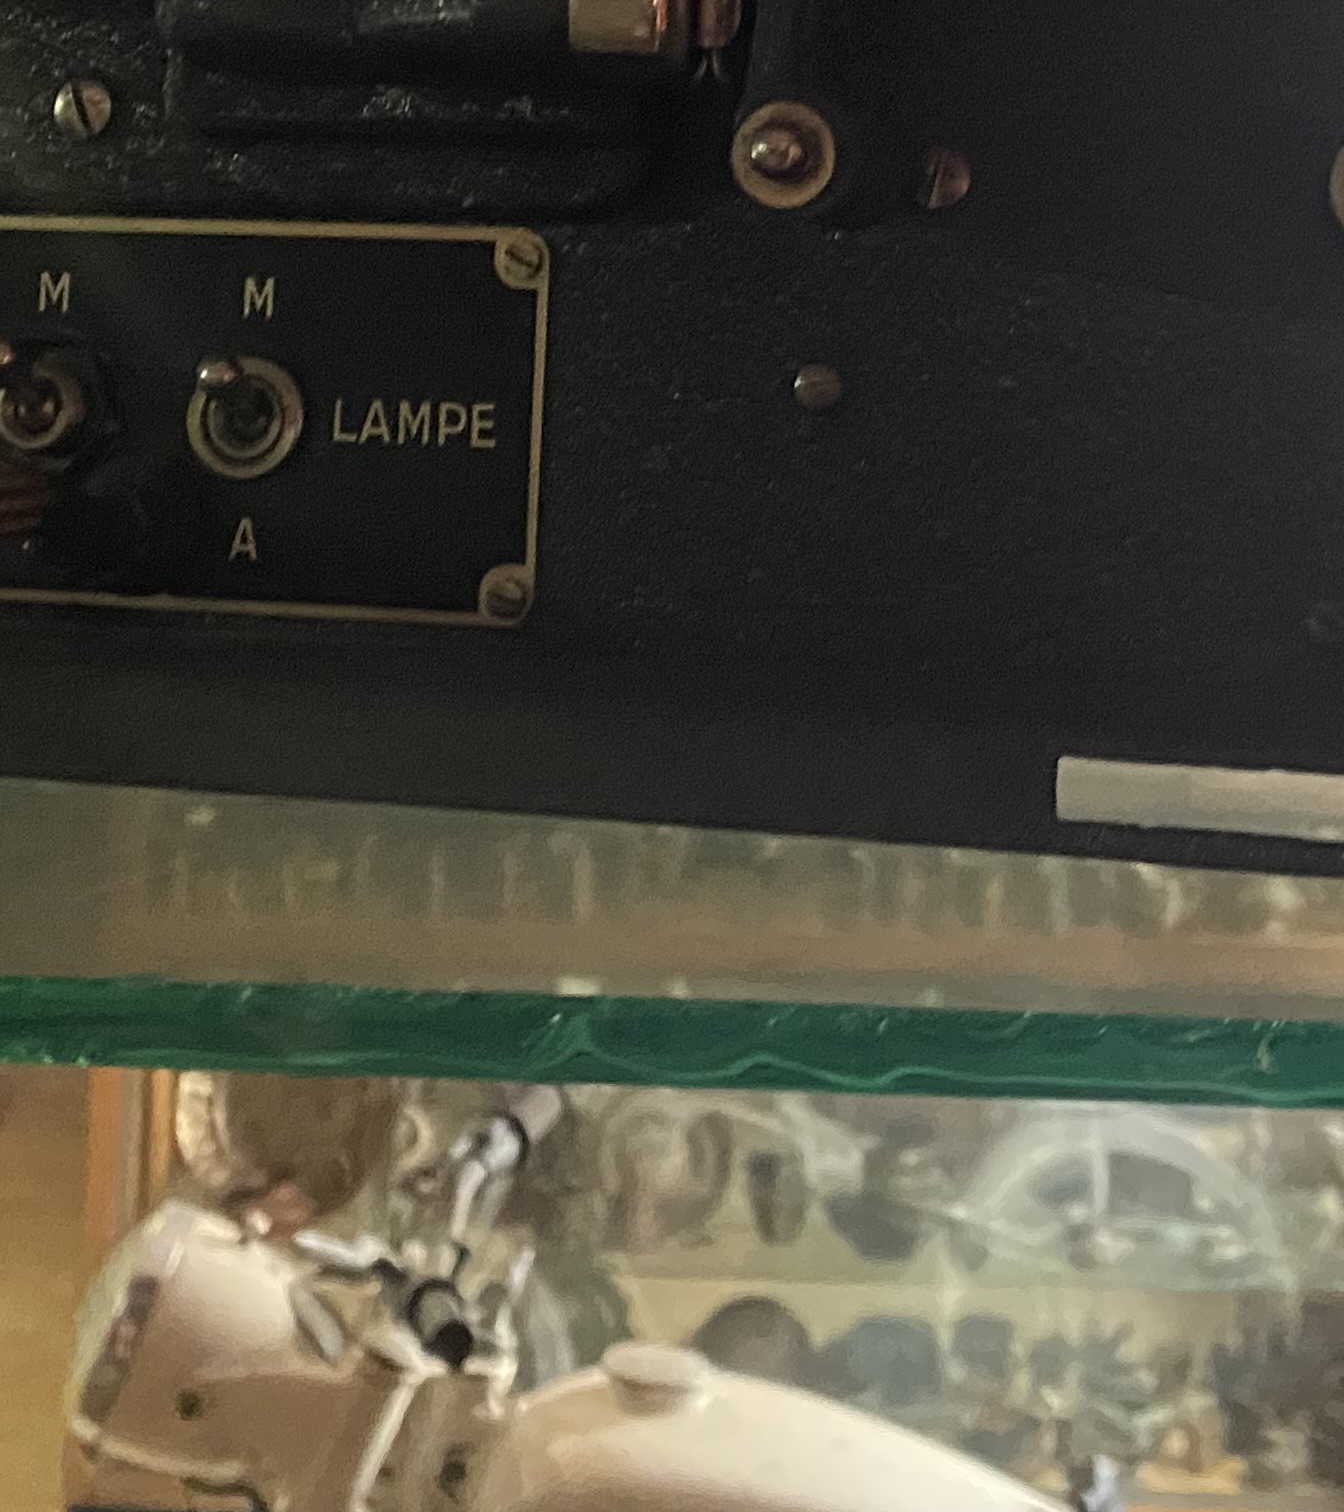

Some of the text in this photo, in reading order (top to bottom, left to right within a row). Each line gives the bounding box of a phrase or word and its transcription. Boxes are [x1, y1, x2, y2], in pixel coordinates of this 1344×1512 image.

[38, 270, 71, 313] M
[242, 275, 275, 319] M
[331, 397, 497, 450] LAMPE
[227, 516, 258, 562] A
